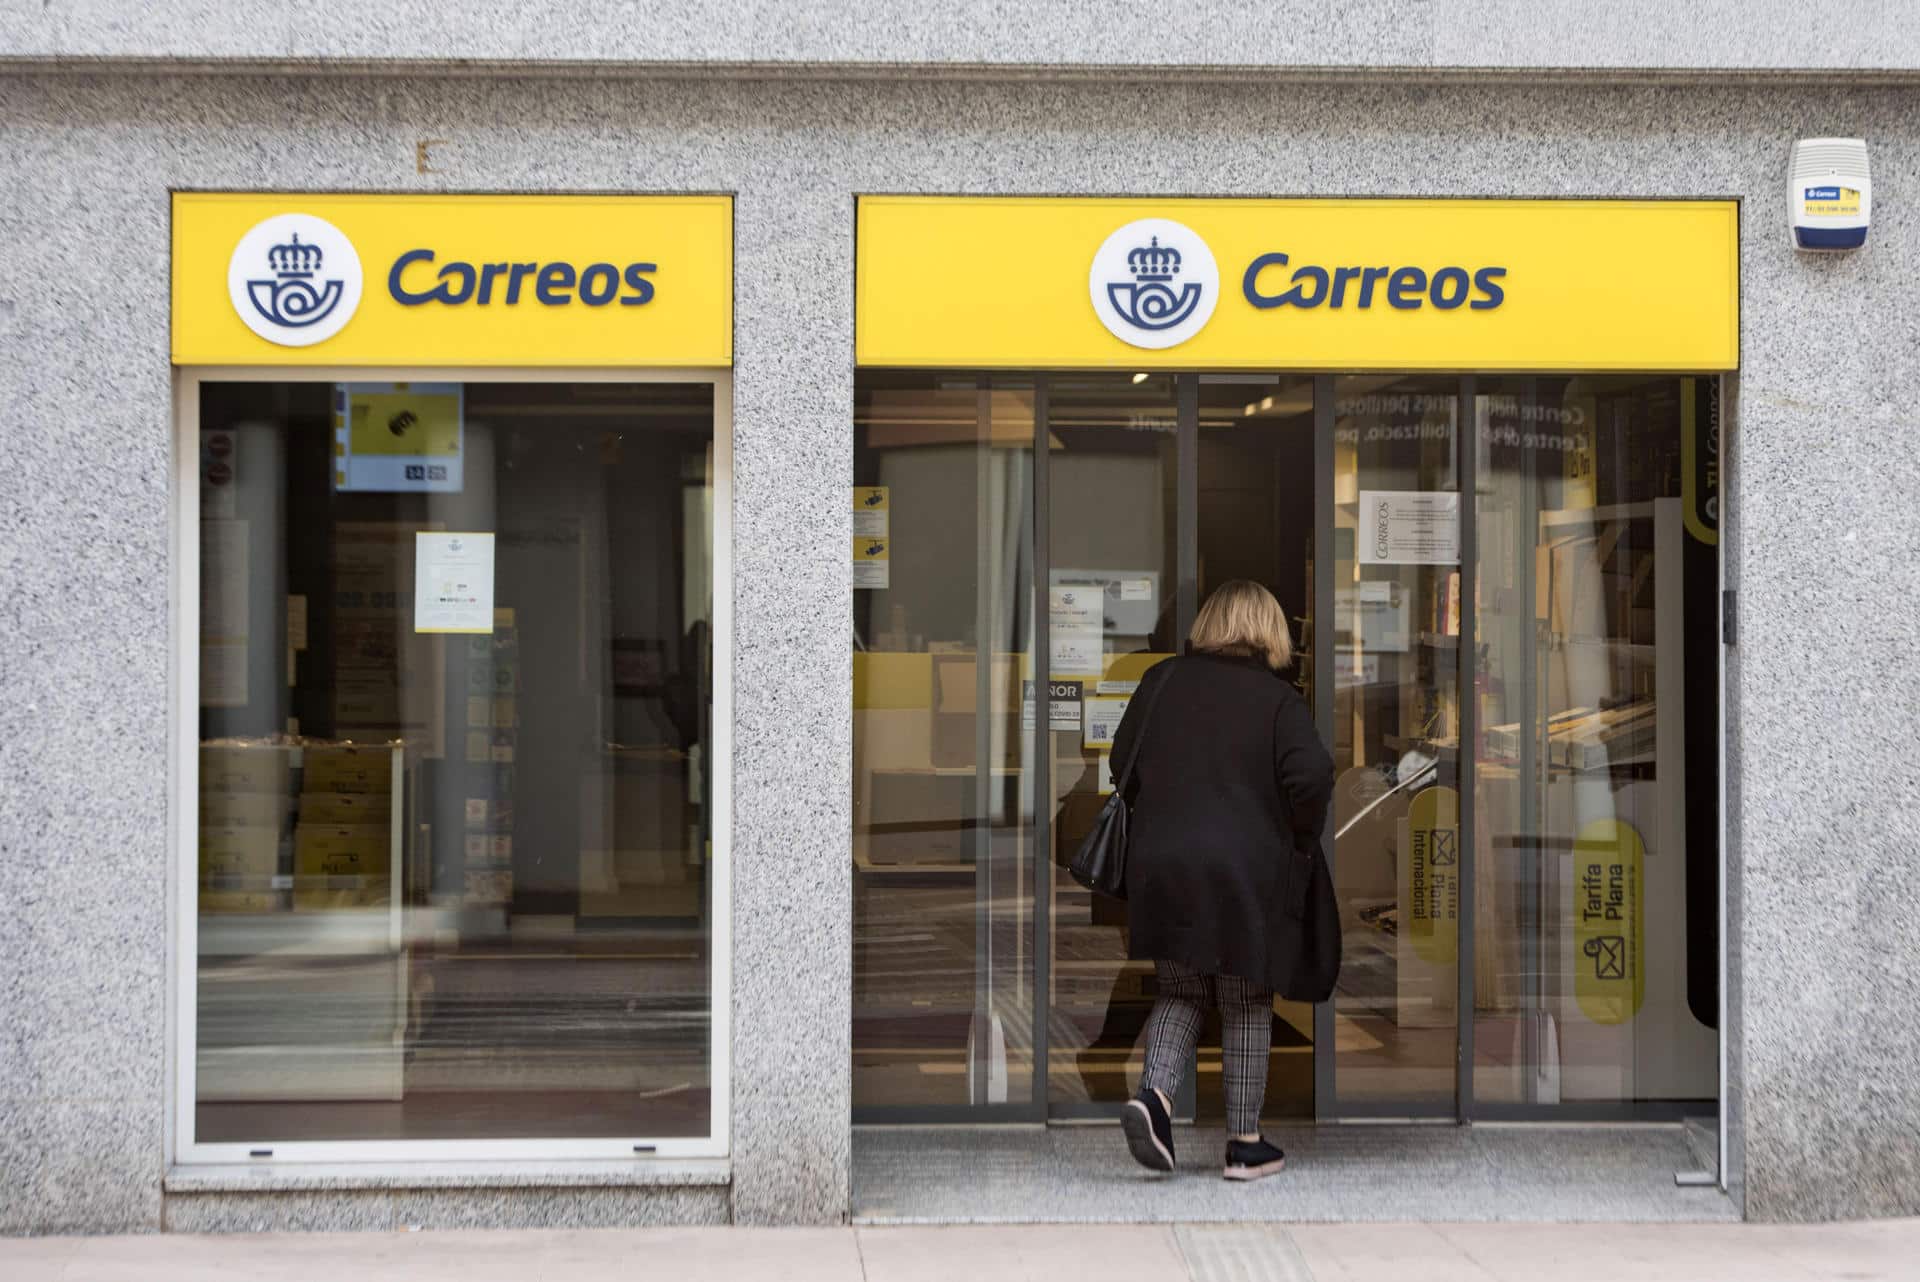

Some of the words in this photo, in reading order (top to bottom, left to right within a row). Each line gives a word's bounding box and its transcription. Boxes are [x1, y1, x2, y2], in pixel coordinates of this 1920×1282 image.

[388, 249, 657, 306] Correos
[1243, 252, 1507, 310] Correos
[1413, 829, 1428, 920] Internacional
[1430, 874, 1445, 920] Plana
[1583, 863, 1602, 922] Tarifa
[1605, 863, 1624, 921] Plana
